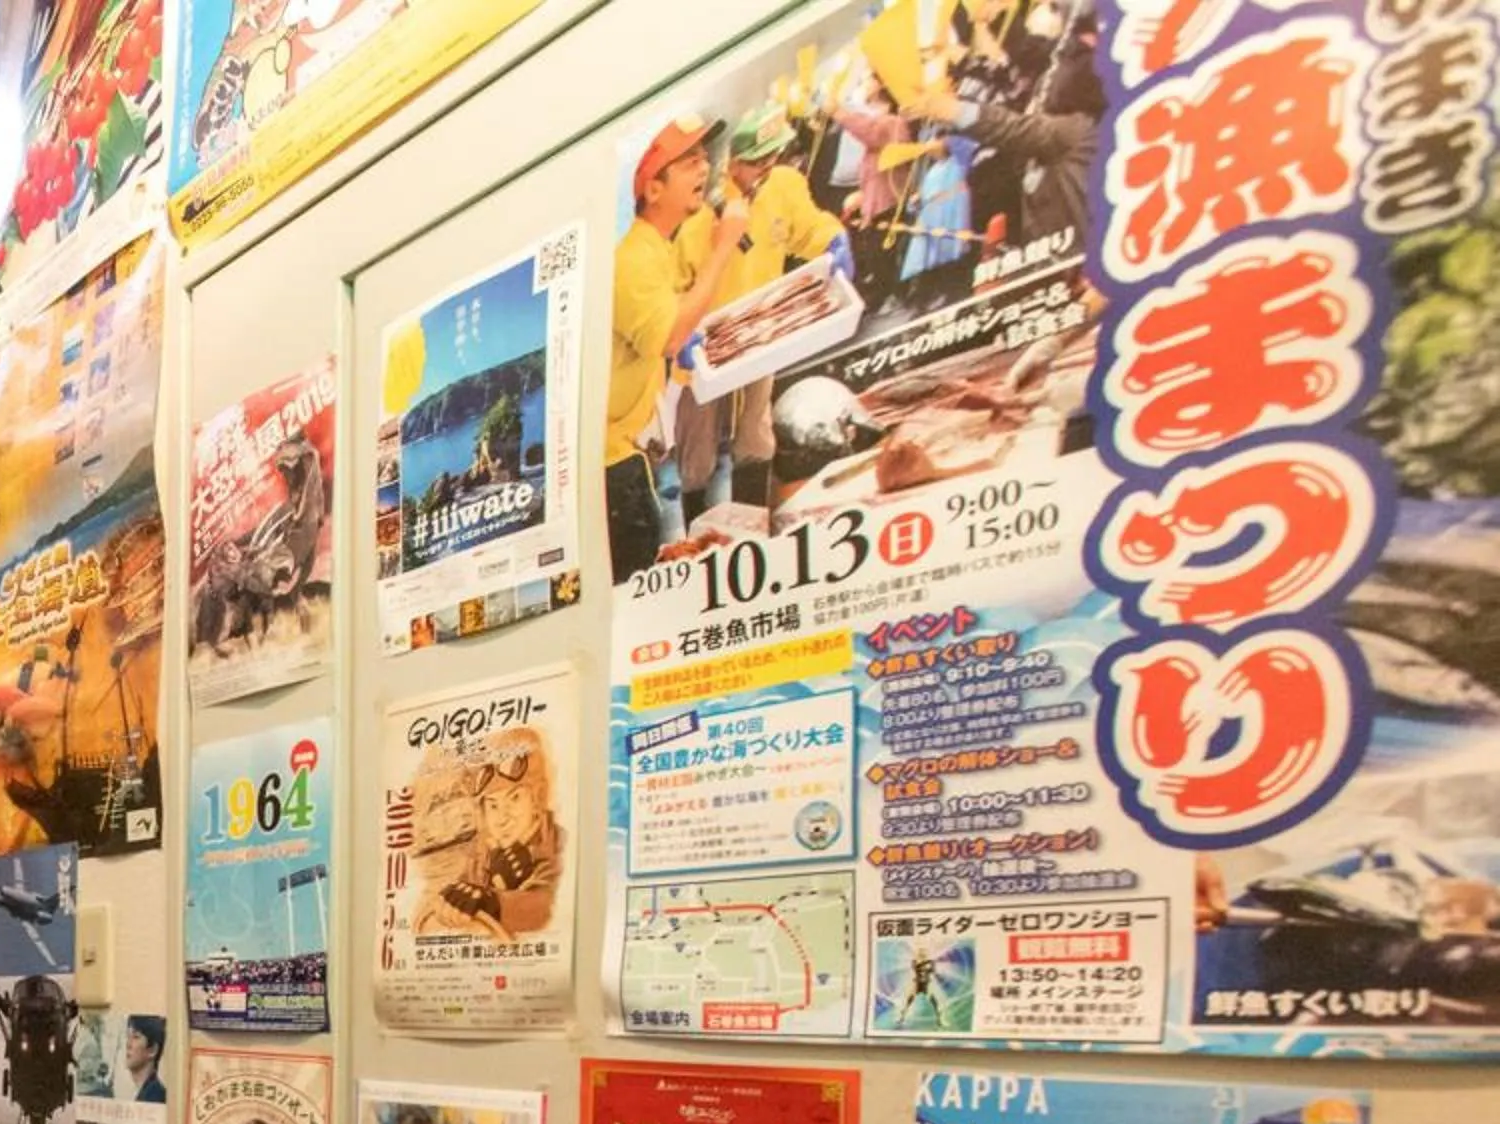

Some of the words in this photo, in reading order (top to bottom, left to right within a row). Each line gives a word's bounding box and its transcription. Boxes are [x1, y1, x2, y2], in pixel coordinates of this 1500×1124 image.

[1112, 0, 1362, 822] 漁まつり
[412, 482, 534, 550] #iiiwate
[966, 504, 1060, 551] 15:00
[632, 561, 692, 600] 2019
[696, 509, 870, 615] 10.13
[887, 514, 924, 563] 日
[678, 603, 801, 657] 石巻魚市場
[868, 605, 978, 651] イベント
[636, 722, 845, 775] 全国豊かな海づくり大会
[202, 766, 315, 843] 1964
[386, 786, 415, 850] 2019
[876, 911, 1159, 938] 仮面ライダーゼロワンショー
[1027, 985, 1145, 1000] メインステージ
[1204, 986, 1433, 1020] 鮮魚すくい取り
[914, 1072, 1049, 1115] KAPPA
